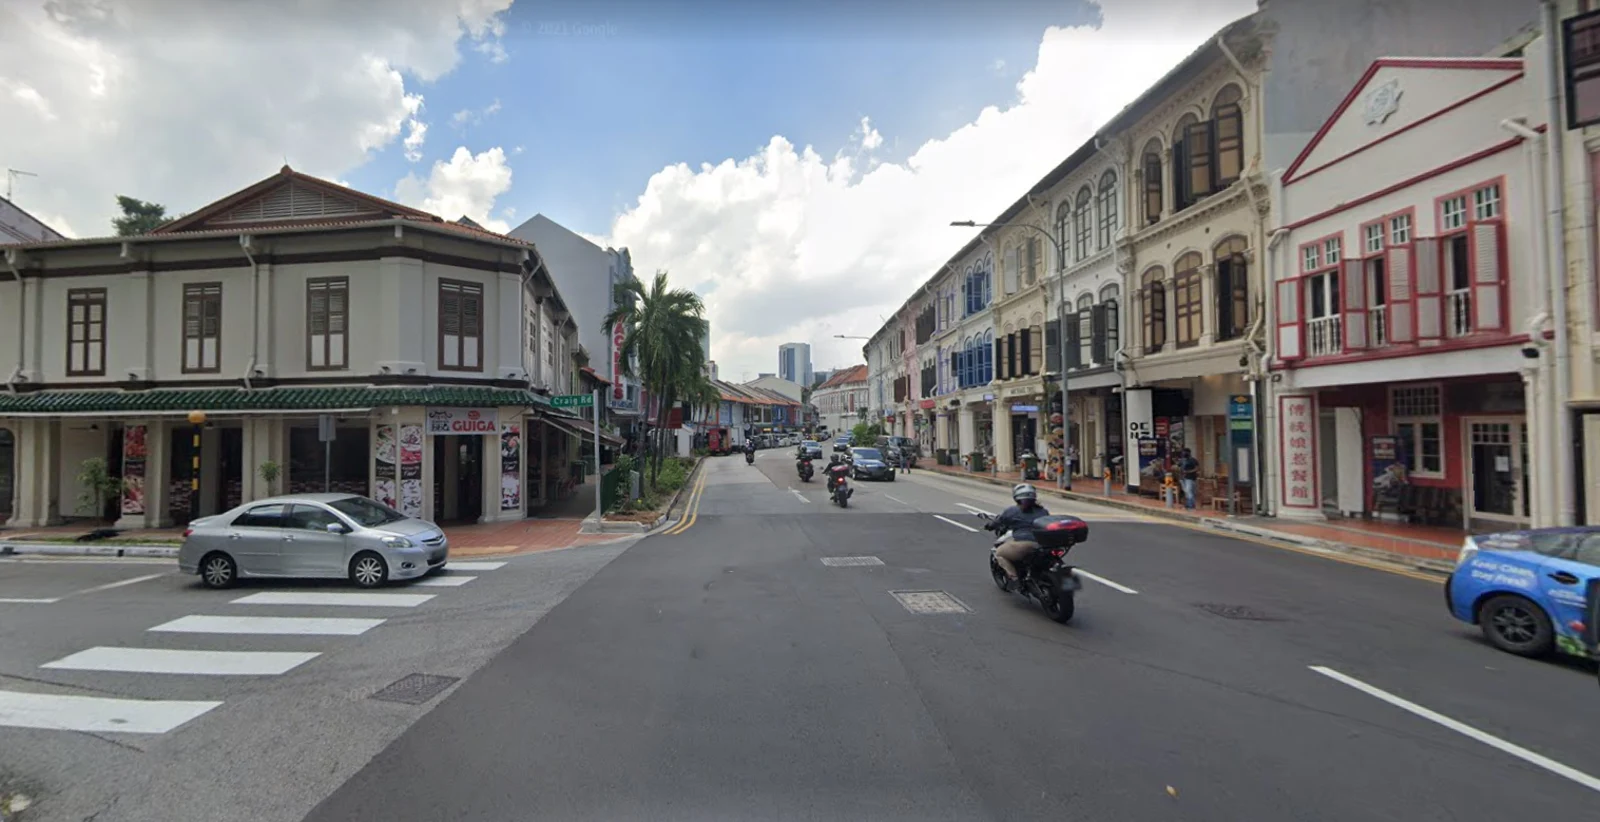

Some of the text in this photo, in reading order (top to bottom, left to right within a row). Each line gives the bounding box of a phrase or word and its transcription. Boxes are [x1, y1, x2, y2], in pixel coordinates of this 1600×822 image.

[553, 395, 592, 406] Craig Rd
[452, 420, 496, 432] GUIGA
[1471, 559, 1497, 571] Keep
[1471, 569, 1530, 588] Stay Fresh
